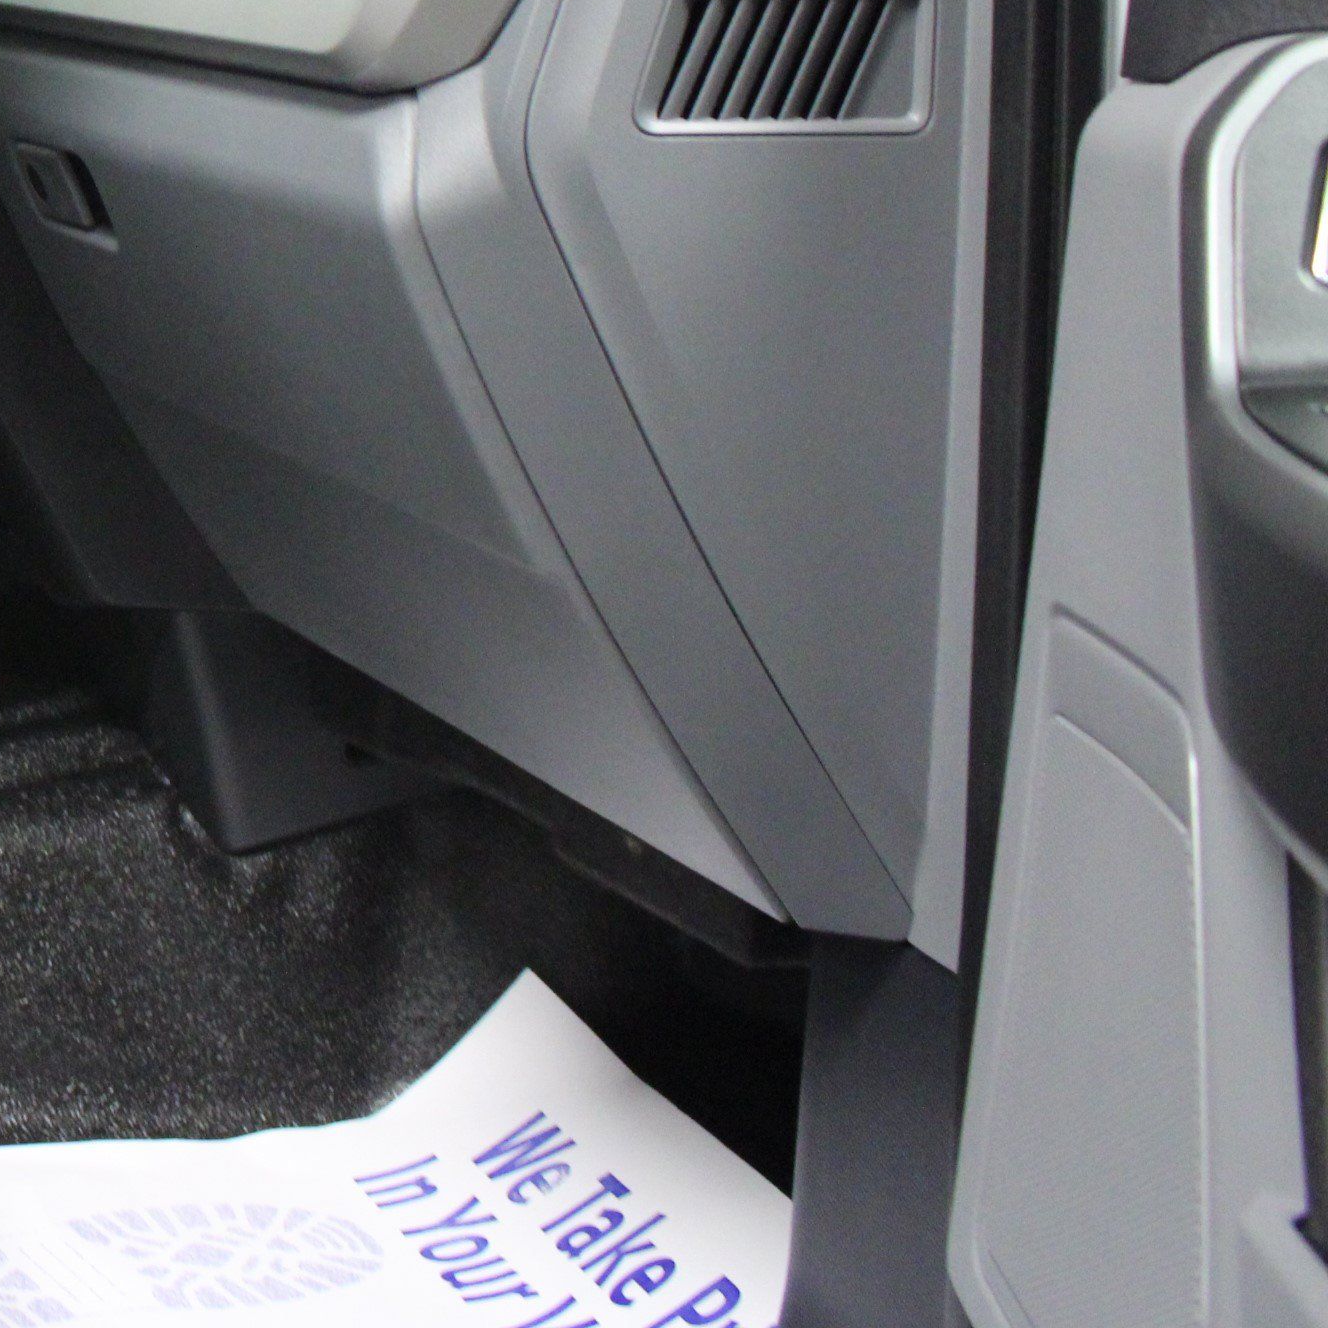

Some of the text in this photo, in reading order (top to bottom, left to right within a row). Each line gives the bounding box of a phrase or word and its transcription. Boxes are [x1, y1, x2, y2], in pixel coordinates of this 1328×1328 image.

[353, 1153, 539, 1302] In Your
[472, 1109, 576, 1205] We
[541, 1172, 676, 1306] Take
